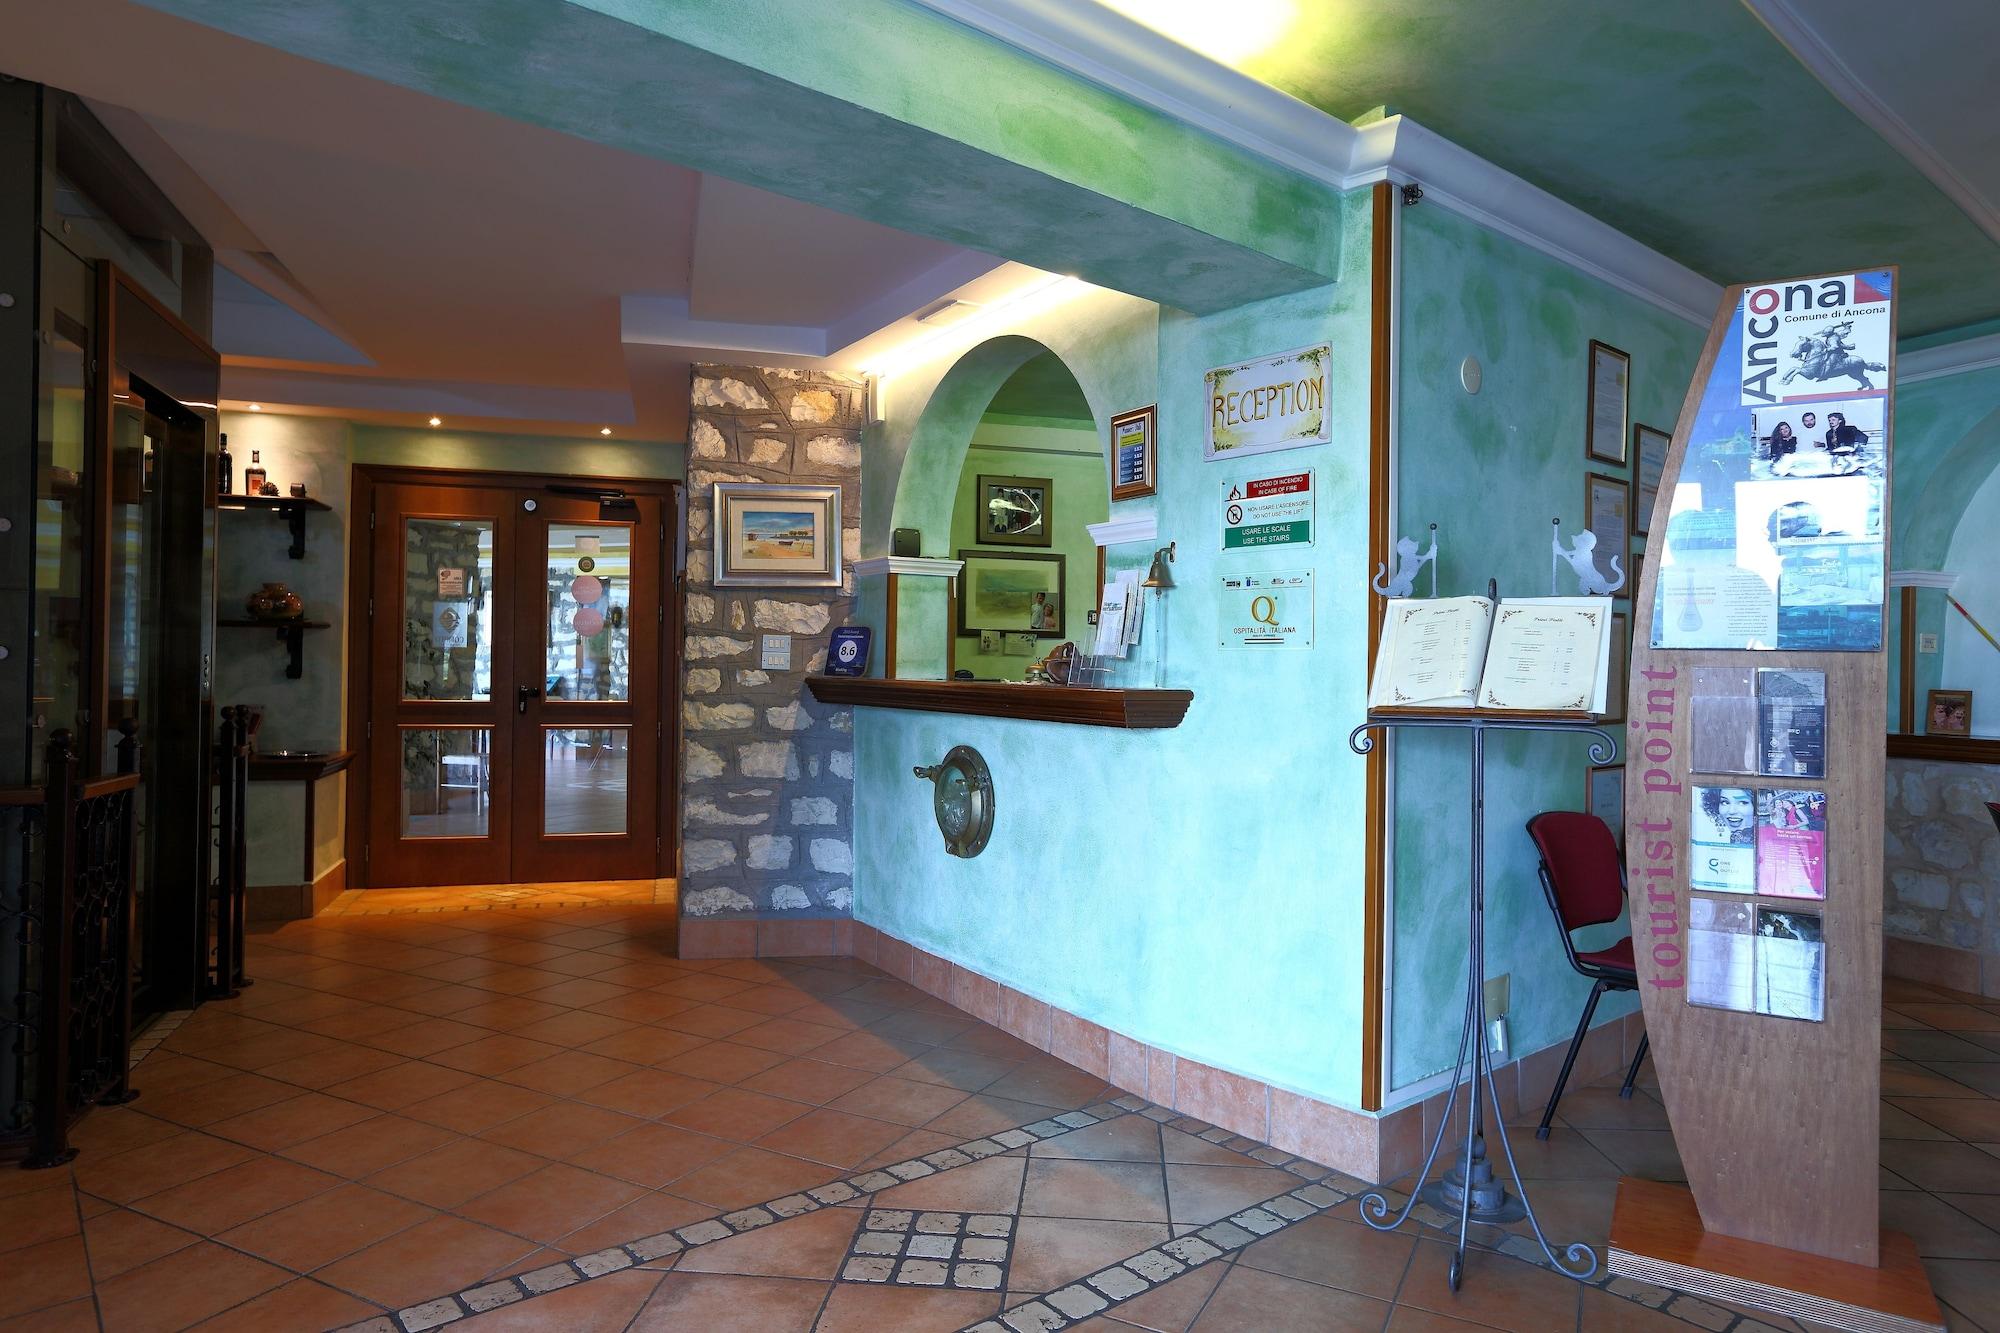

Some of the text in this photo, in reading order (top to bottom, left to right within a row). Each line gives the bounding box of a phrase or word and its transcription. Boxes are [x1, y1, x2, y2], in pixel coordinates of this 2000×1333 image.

[1784, 306, 1886, 323] Comune di Ancona
[1743, 281, 1846, 402] Ancona
[1212, 375, 1325, 430] RECEPTION
[1279, 476, 1303, 485] INCENDIO
[1242, 527, 1261, 536] USARE
[1272, 524, 1291, 533] SCALE
[1242, 537, 1255, 545] USE
[1269, 534, 1290, 542] STAIRS
[1251, 595, 1280, 626] Q
[1233, 625, 1296, 634] OSPITALITÀ ITALIANA
[1631, 665, 1685, 991] tourist point
